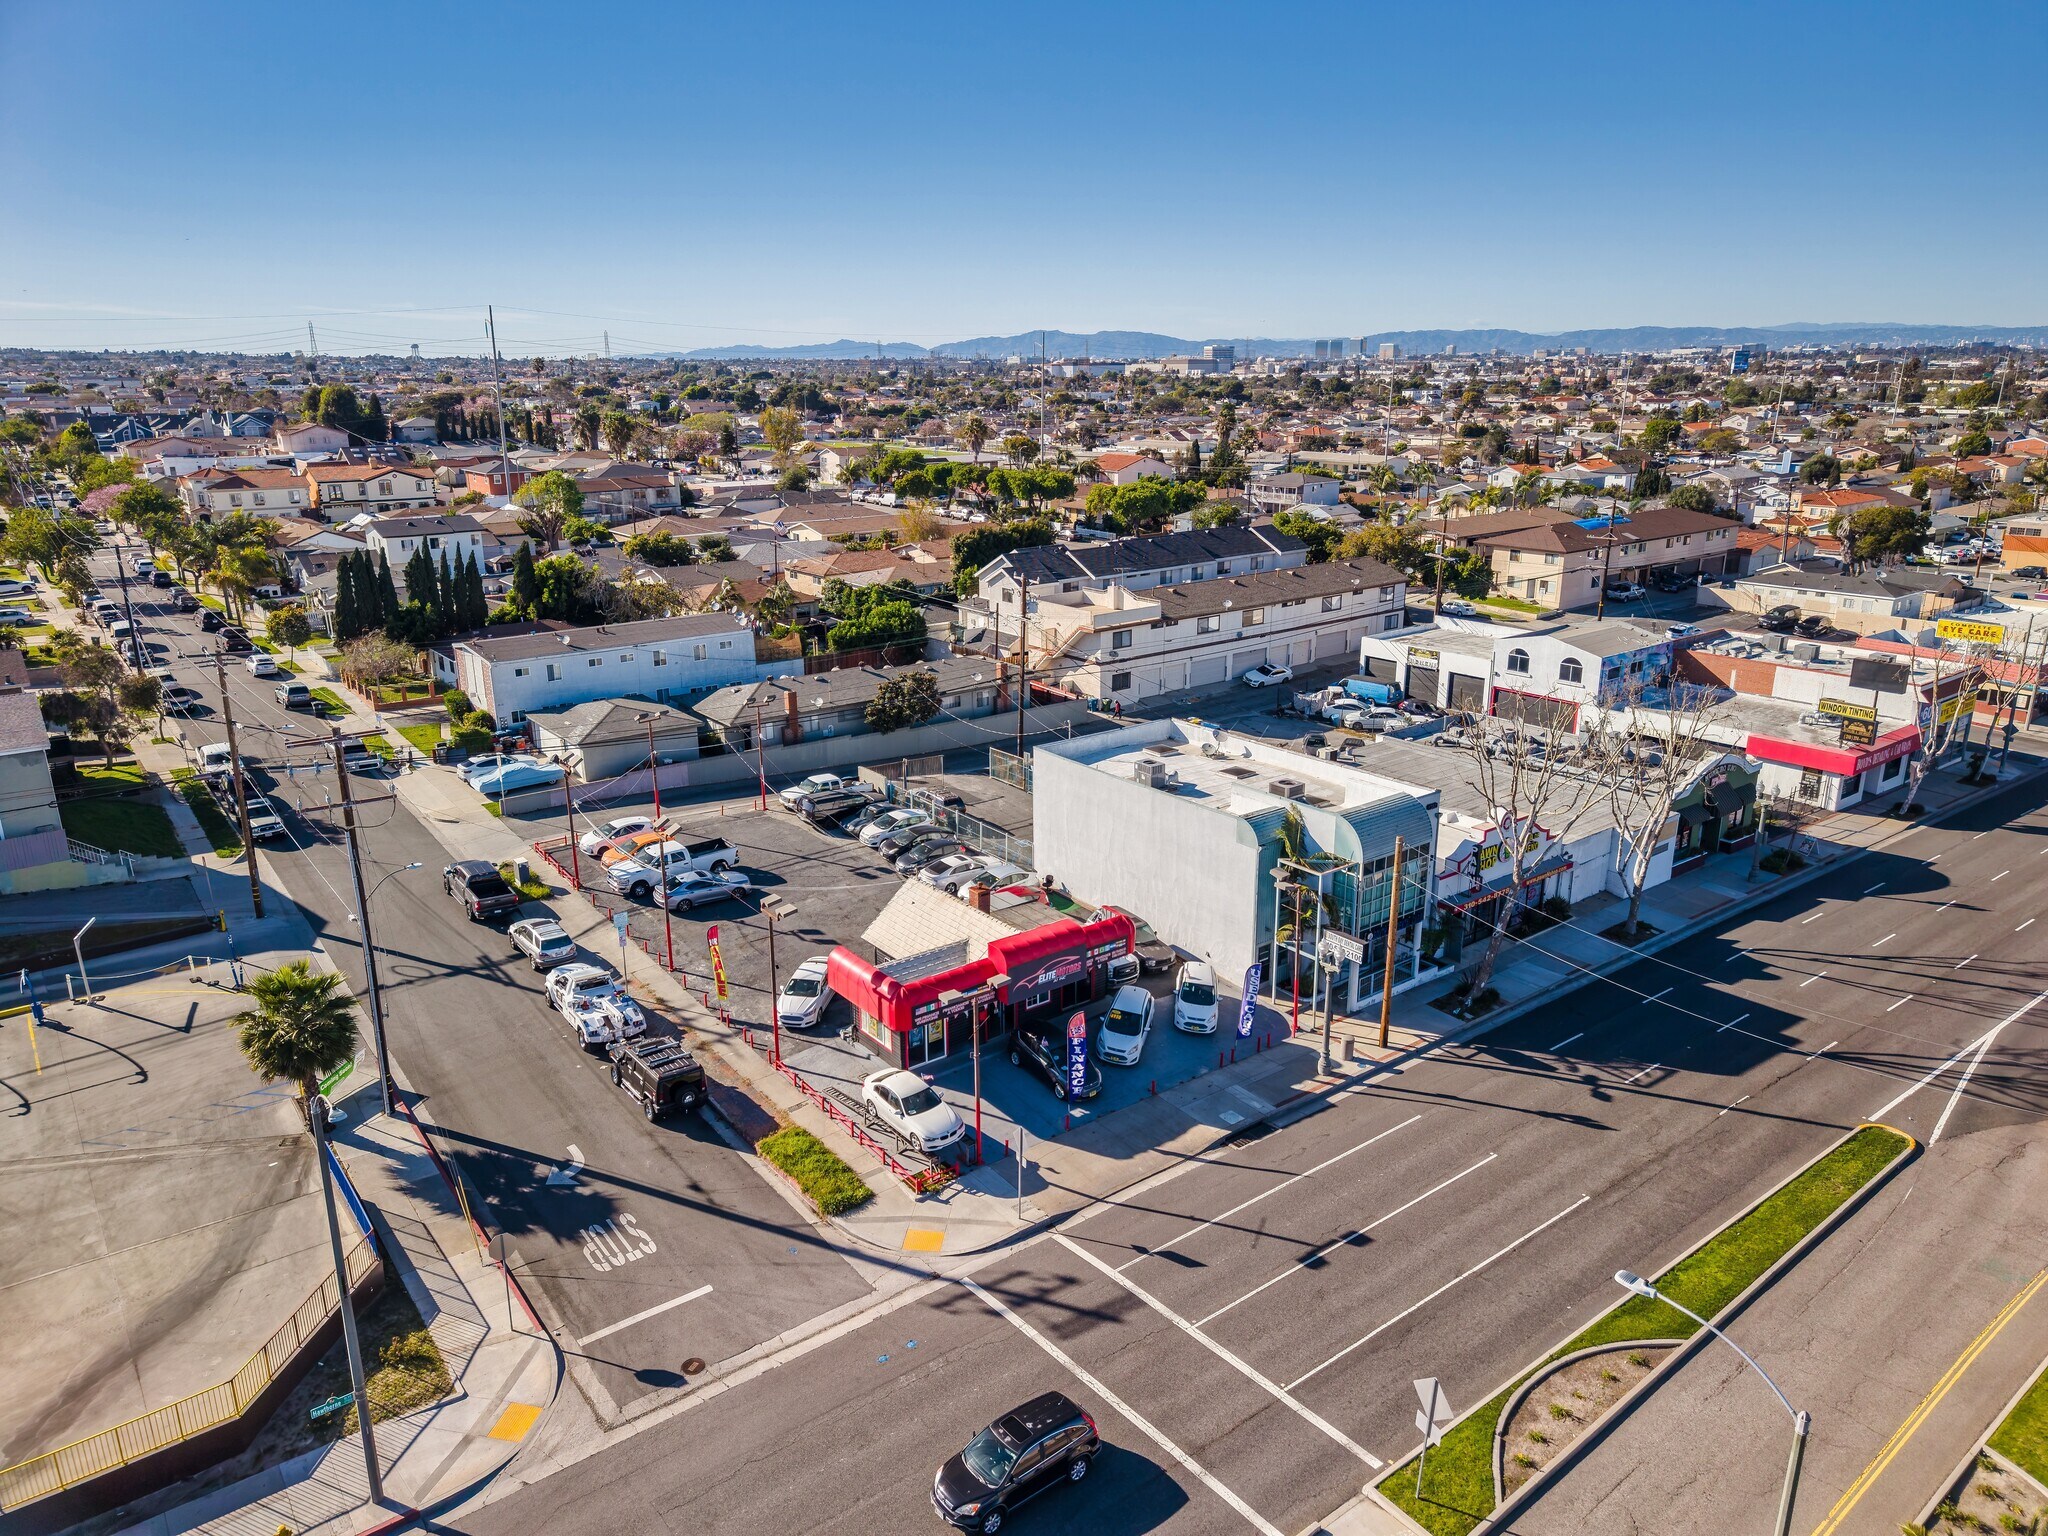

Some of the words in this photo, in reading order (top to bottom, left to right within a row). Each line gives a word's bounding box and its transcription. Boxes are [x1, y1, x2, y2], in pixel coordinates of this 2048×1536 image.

[1942, 625, 1963, 634] EYE
[1968, 628, 1997, 638] CARE
[1950, 621, 1992, 631] COMPLETE
[1953, 633, 1985, 641] CENTER
[1820, 701, 1848, 714] WINDOW
[1849, 706, 1874, 719] TINTING
[1480, 844, 1499, 860] AWN
[1480, 857, 1497, 871] HOP
[712, 946, 728, 998] SALE
[1038, 969, 1057, 984] ELITE
[1056, 961, 1082, 977] MOTORS
[1246, 968, 1261, 1002] USED
[1241, 1005, 1255, 1036] CARS
[1070, 1037, 1085, 1095] FINANCE
[580, 1212, 657, 1272] STOP
[312, 1401, 342, 1418] Hawthorne
